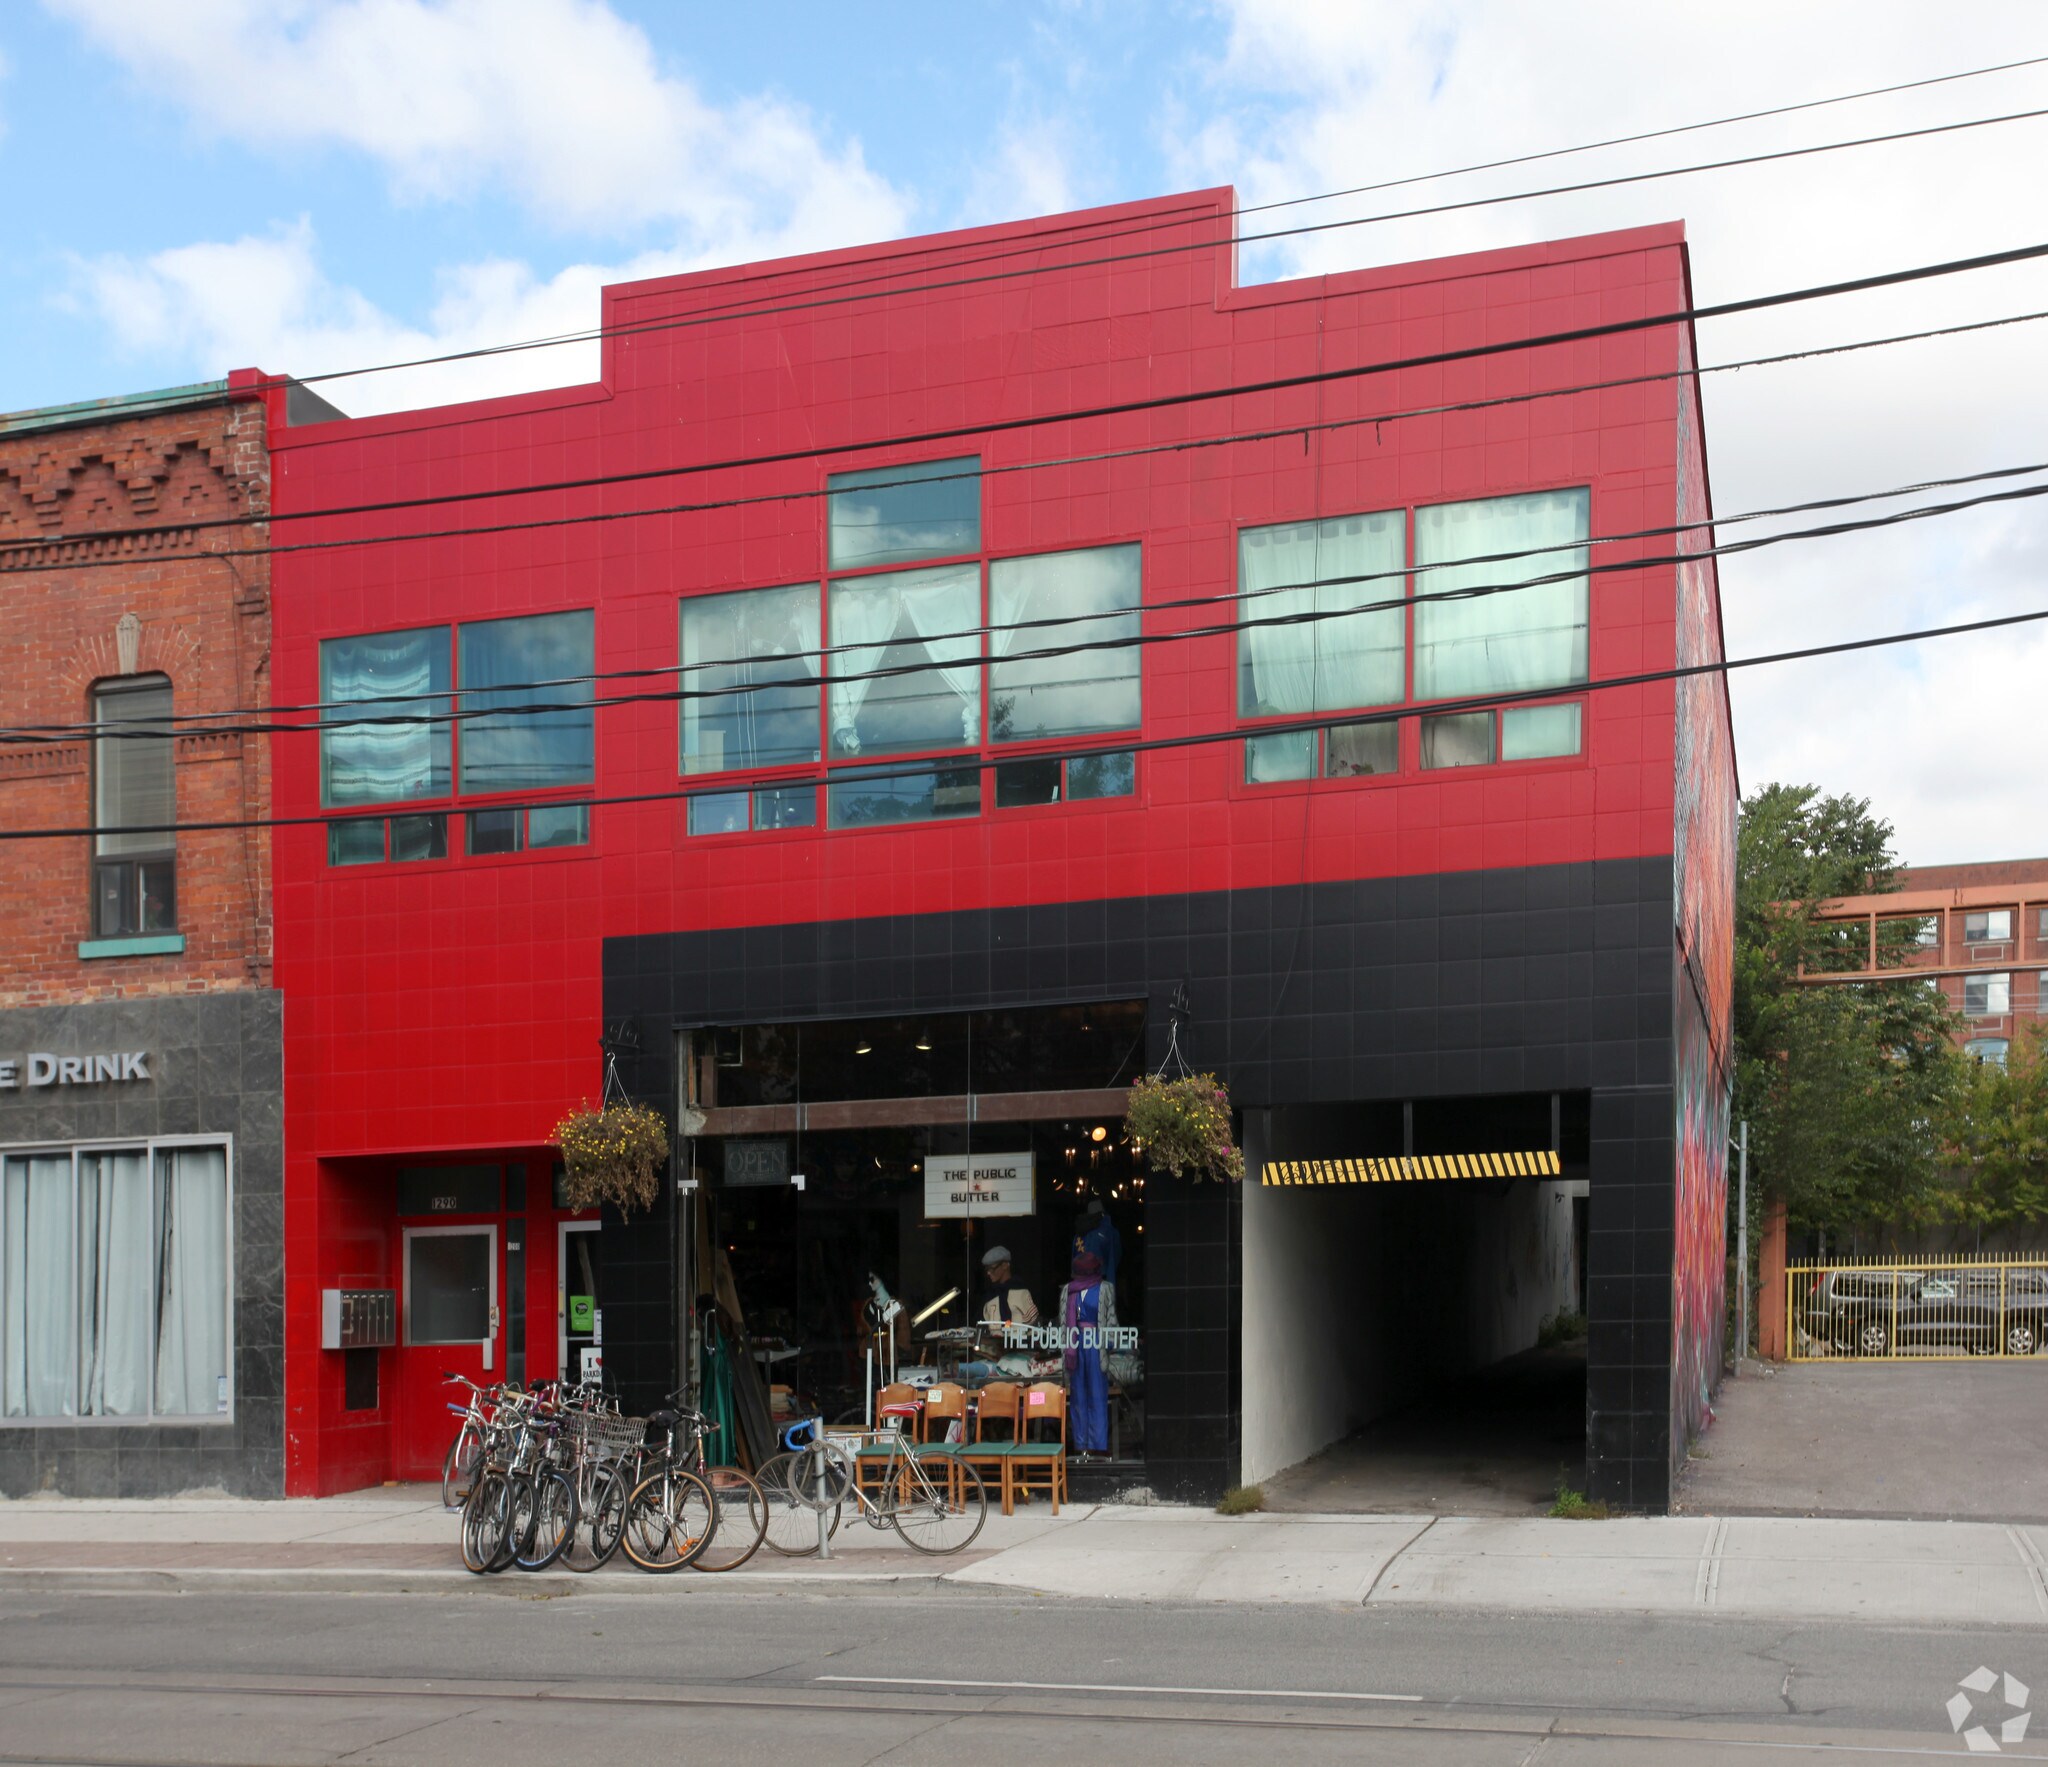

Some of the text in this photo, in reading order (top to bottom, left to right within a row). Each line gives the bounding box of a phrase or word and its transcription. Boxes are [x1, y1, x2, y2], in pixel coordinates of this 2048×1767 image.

[728, 1151, 786, 1174] OPEN
[943, 1168, 1017, 1181] THE PUBLIC
[432, 1197, 456, 1210] 1290
[950, 1191, 1000, 1203] BUTTER
[1002, 1326, 1139, 1349] THE PUBLIC BUTTER
[587, 1357, 593, 1368] I
